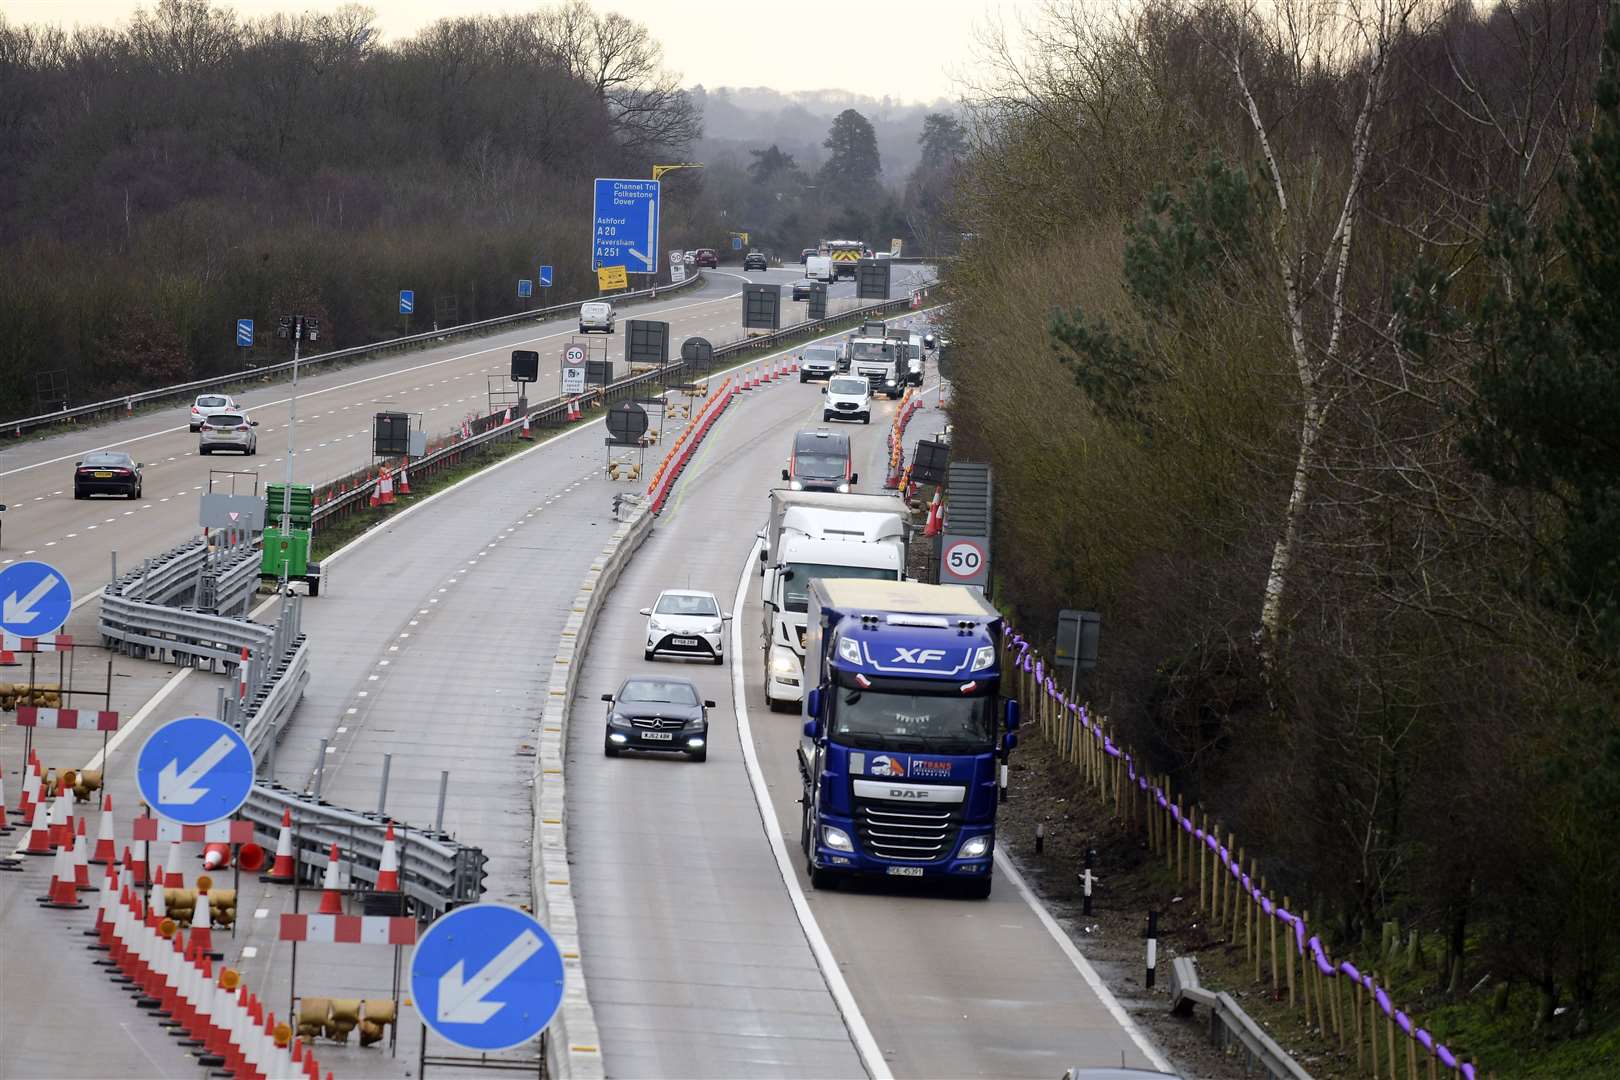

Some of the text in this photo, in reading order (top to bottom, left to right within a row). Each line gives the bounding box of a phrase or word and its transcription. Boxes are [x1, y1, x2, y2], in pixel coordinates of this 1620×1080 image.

[598, 216, 626, 224] Ashford
[568, 351, 582, 360] 50
[951, 552, 979, 568] 50
[891, 648, 946, 664] XF
[890, 790, 928, 798] DAF
